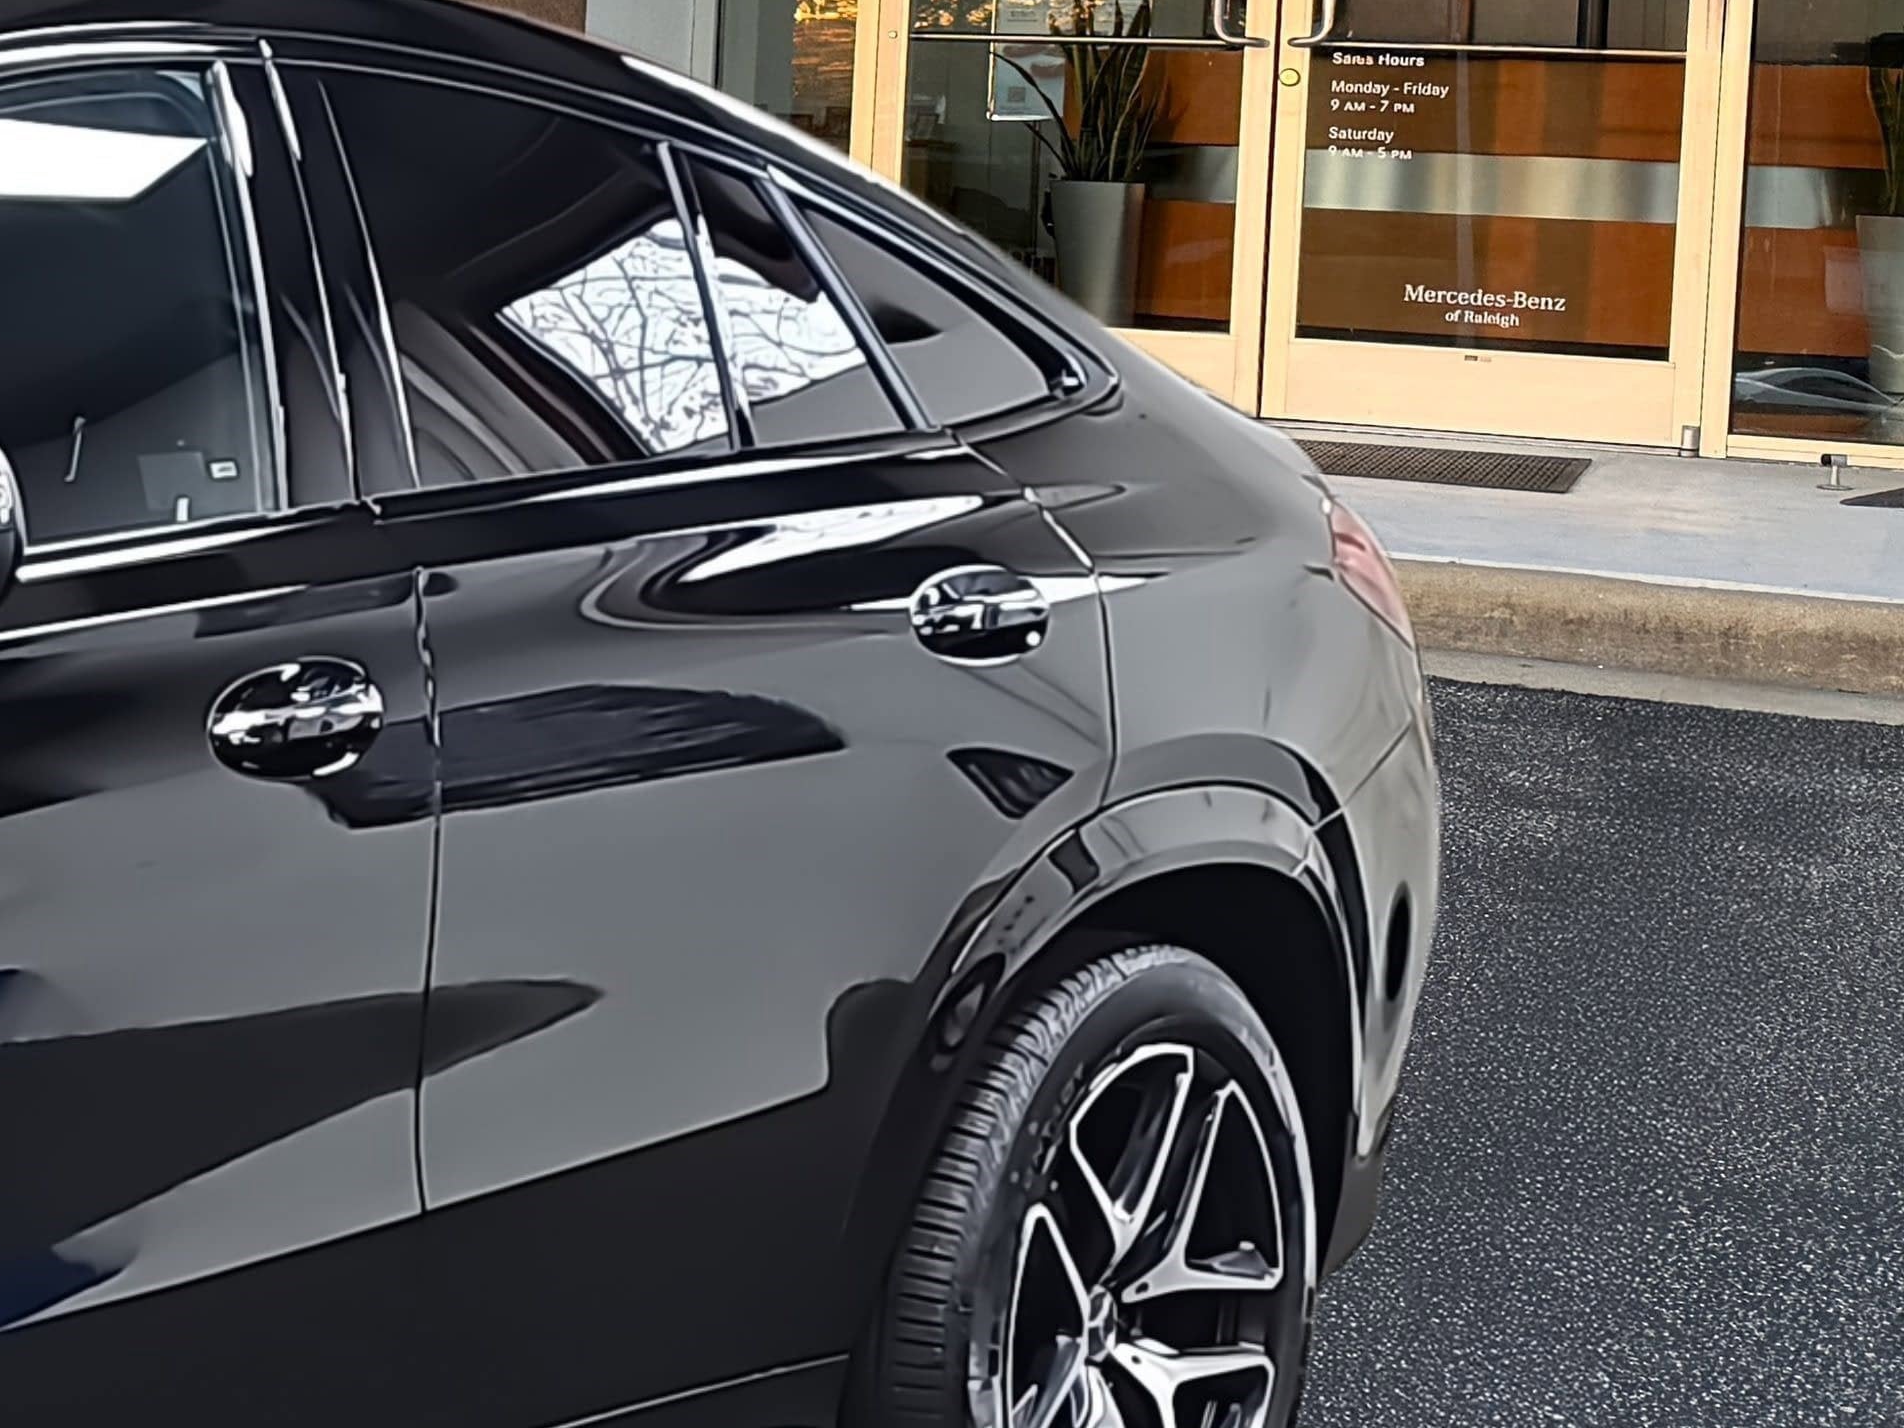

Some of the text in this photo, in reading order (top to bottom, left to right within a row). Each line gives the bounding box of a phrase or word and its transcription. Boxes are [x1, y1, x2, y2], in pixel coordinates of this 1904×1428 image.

[1378, 52, 1425, 67] Hours
[1331, 80, 1390, 97] Monday
[1403, 82, 1449, 98] Friday
[1330, 99, 1340, 111] 9
[1344, 101, 1365, 111] AM
[1379, 100, 1389, 112] 7
[1393, 103, 1415, 113] PM
[1328, 127, 1394, 143] Saturday
[1328, 145, 1337, 157] 9
[1342, 148, 1363, 158] AM
[1377, 147, 1387, 158] 5
[1391, 150, 1412, 159] PM
[1404, 283, 1566, 312] Mercedes-Benz
[1445, 310, 1520, 329] of Raleigh
